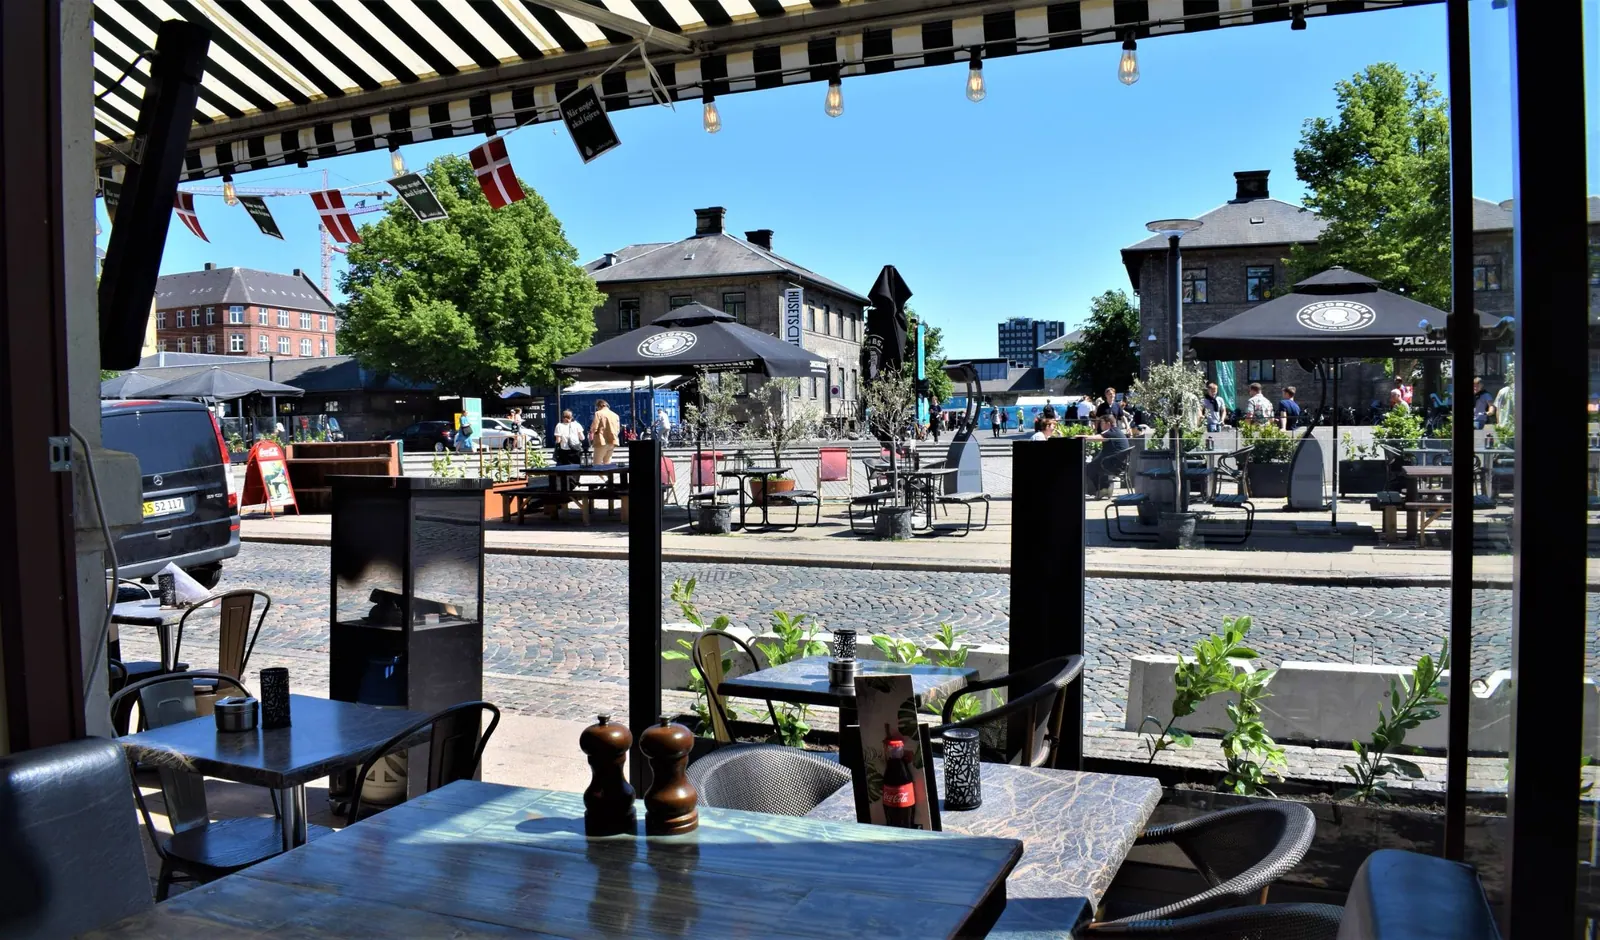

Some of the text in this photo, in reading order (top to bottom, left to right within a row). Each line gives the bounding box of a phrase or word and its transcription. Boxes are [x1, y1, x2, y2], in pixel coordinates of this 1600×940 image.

[566, 99, 594, 119] Når noget
[571, 117, 585, 129] skal
[787, 291, 800, 325] HUSETS
[155, 501, 166, 512] 52
[168, 498, 183, 510] 117
[883, 791, 909, 804] Coca-Cola
